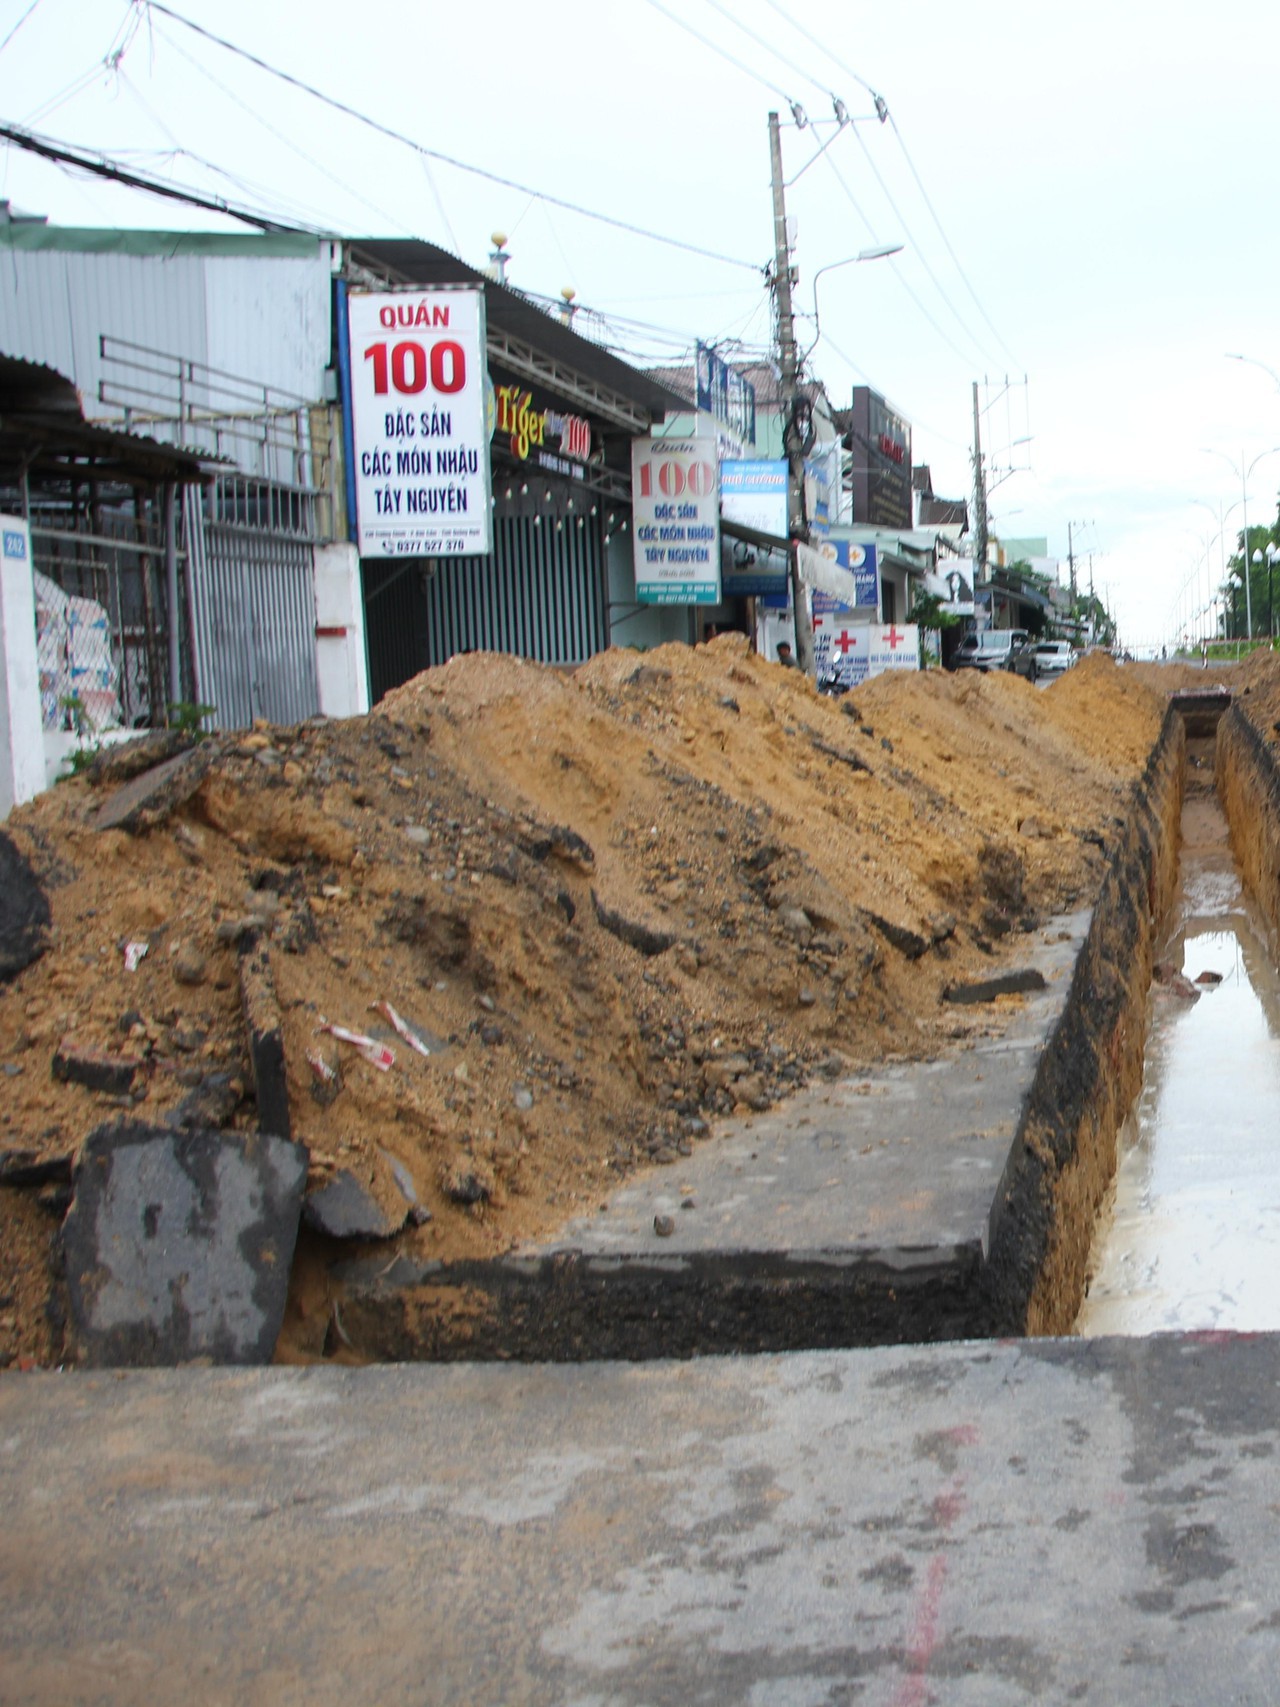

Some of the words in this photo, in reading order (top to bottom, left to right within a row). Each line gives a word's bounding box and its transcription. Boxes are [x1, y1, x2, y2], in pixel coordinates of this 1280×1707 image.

[379, 298, 450, 330] QUÁN
[363, 339, 467, 396] 100
[385, 405, 415, 444] ĐẶC
[420, 403, 452, 438] SẢN
[497, 385, 546, 460] Tiger
[563, 412, 591, 462] 100
[361, 446, 392, 477] CÁC
[396, 444, 432, 476] MÓN
[436, 442, 479, 481] NHẬU
[639, 460, 715, 498] 100
[374, 484, 401, 515] TÂY
[406, 479, 468, 514] NGUYÊN
[654, 503, 675, 523] ĐẶC
[677, 501, 698, 520] SẢN
[638, 524, 658, 541] CÁC
[660, 523, 686, 541] MÓN
[687, 523, 715, 544] NHẬU
[645, 547, 666, 564] TÂY
[667, 546, 710, 564] NGUYÊN
[856, 574, 875, 585] HANG
